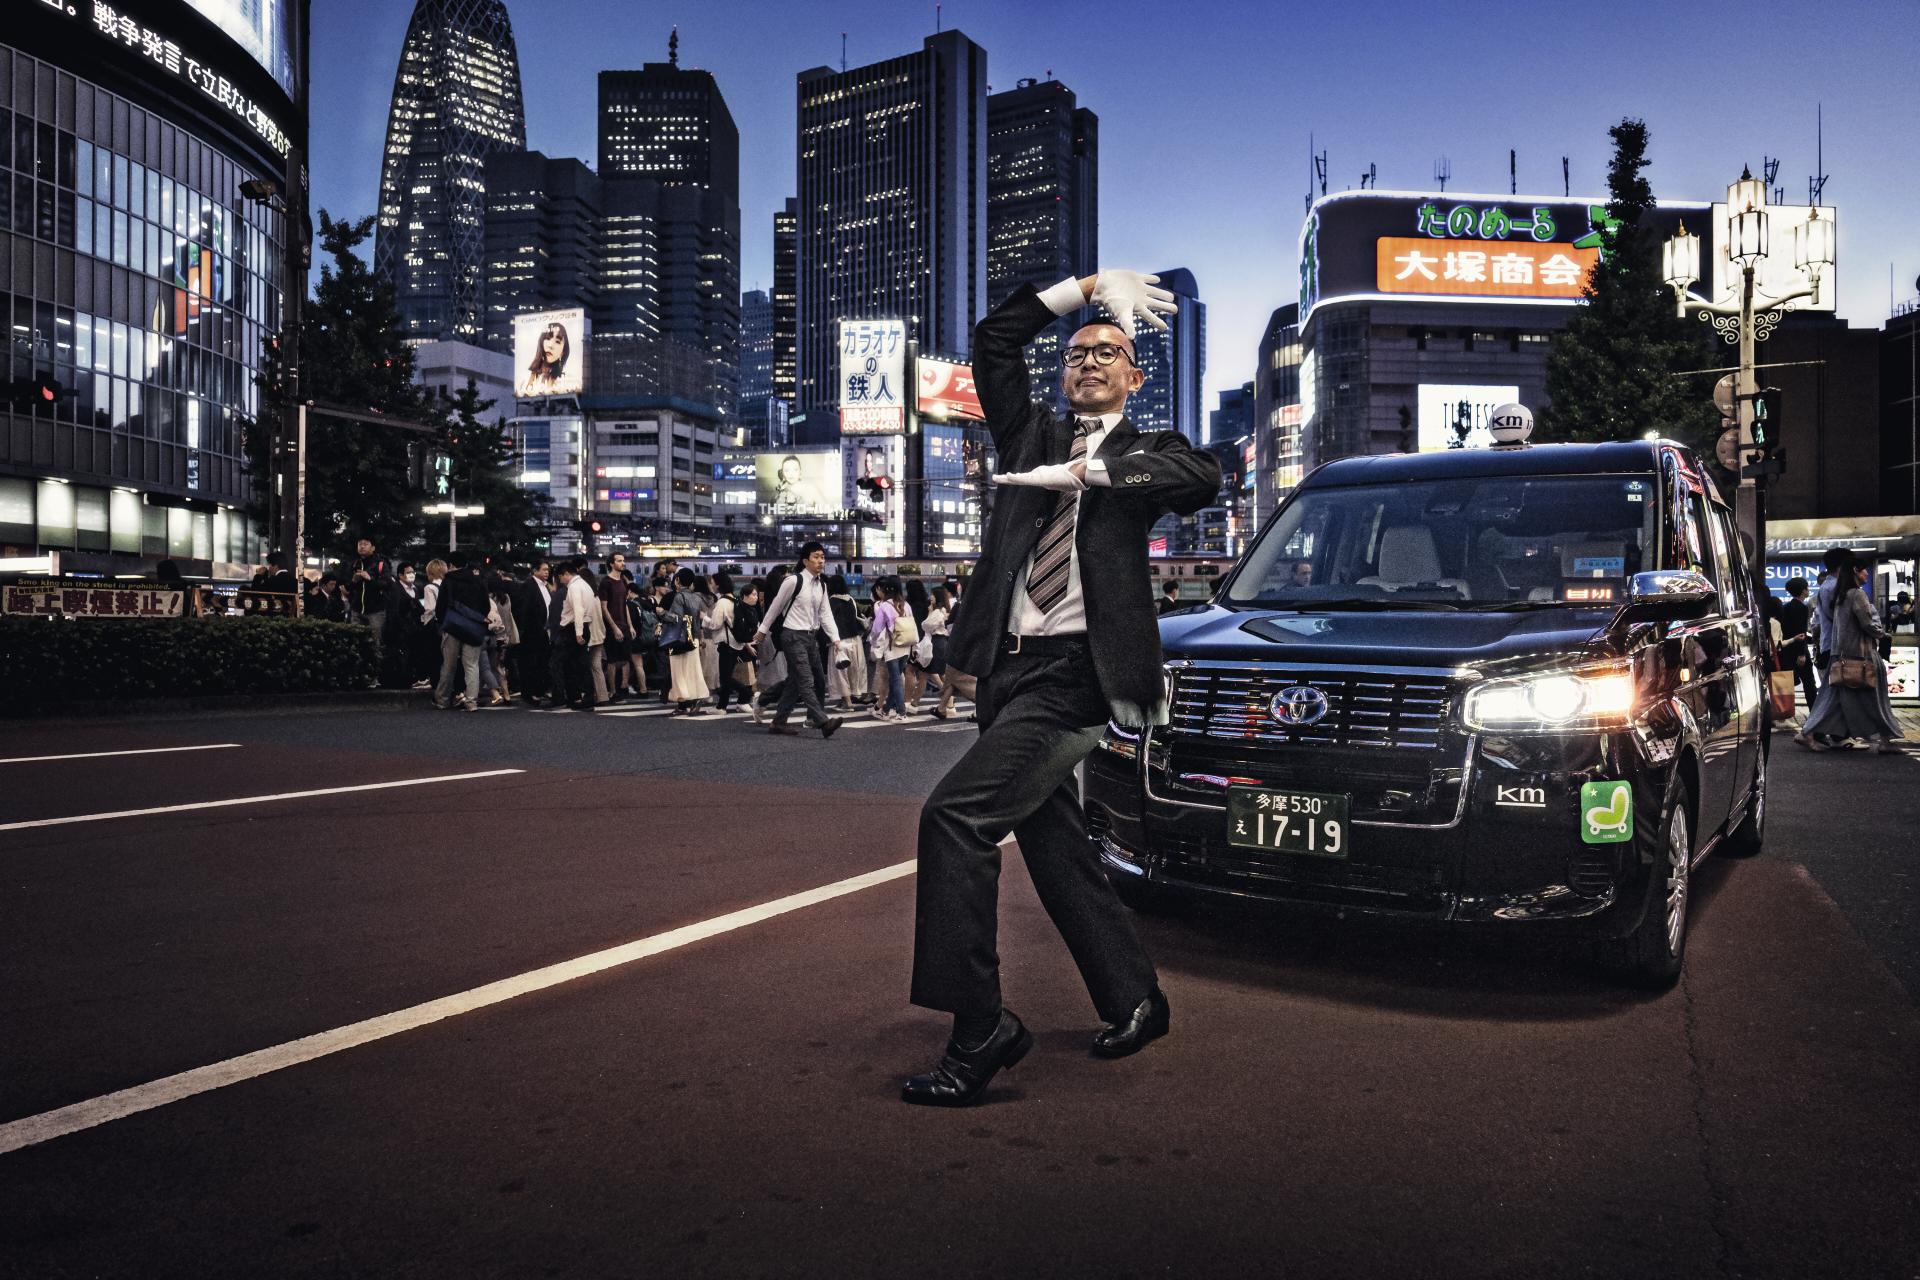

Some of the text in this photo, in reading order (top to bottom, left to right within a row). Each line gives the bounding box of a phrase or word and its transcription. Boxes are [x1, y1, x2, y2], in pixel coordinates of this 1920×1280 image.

[1418, 203, 1557, 241] たのめーる
[1394, 250, 1582, 287] 大塚商会
[843, 325, 902, 358] カラオケ
[865, 356, 878, 376] の
[846, 374, 896, 403] 鉄人
[1256, 793, 1321, 815] 多摩 530
[1496, 784, 1546, 807] km
[1235, 813, 1341, 853] え 17-19
